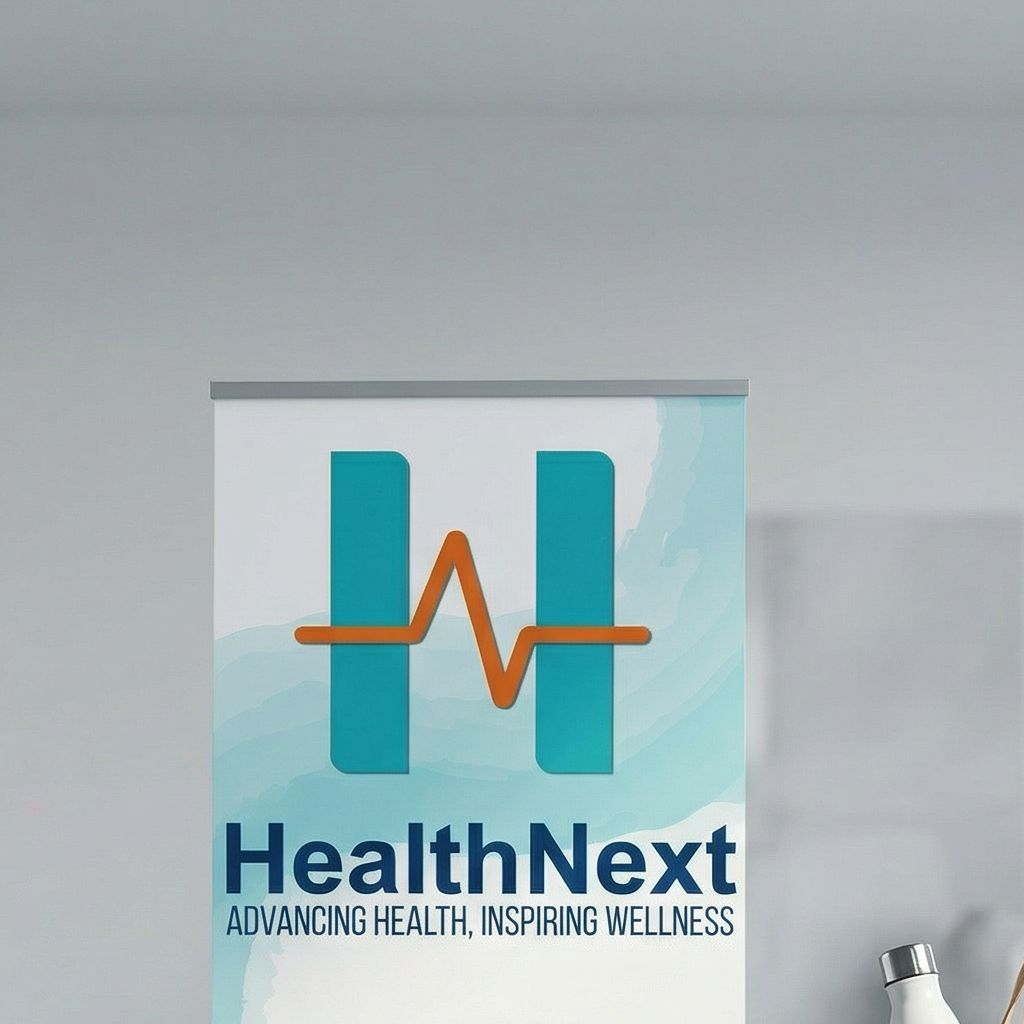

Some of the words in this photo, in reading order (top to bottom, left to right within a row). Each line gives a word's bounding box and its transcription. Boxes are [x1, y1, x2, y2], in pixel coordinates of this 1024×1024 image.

[226, 822, 737, 895] HealthNext
[226, 905, 366, 936] ADVANCING
[374, 905, 473, 939] HEALTH,
[481, 905, 597, 936] INSPIRING
[605, 905, 734, 936] WELLNESS
